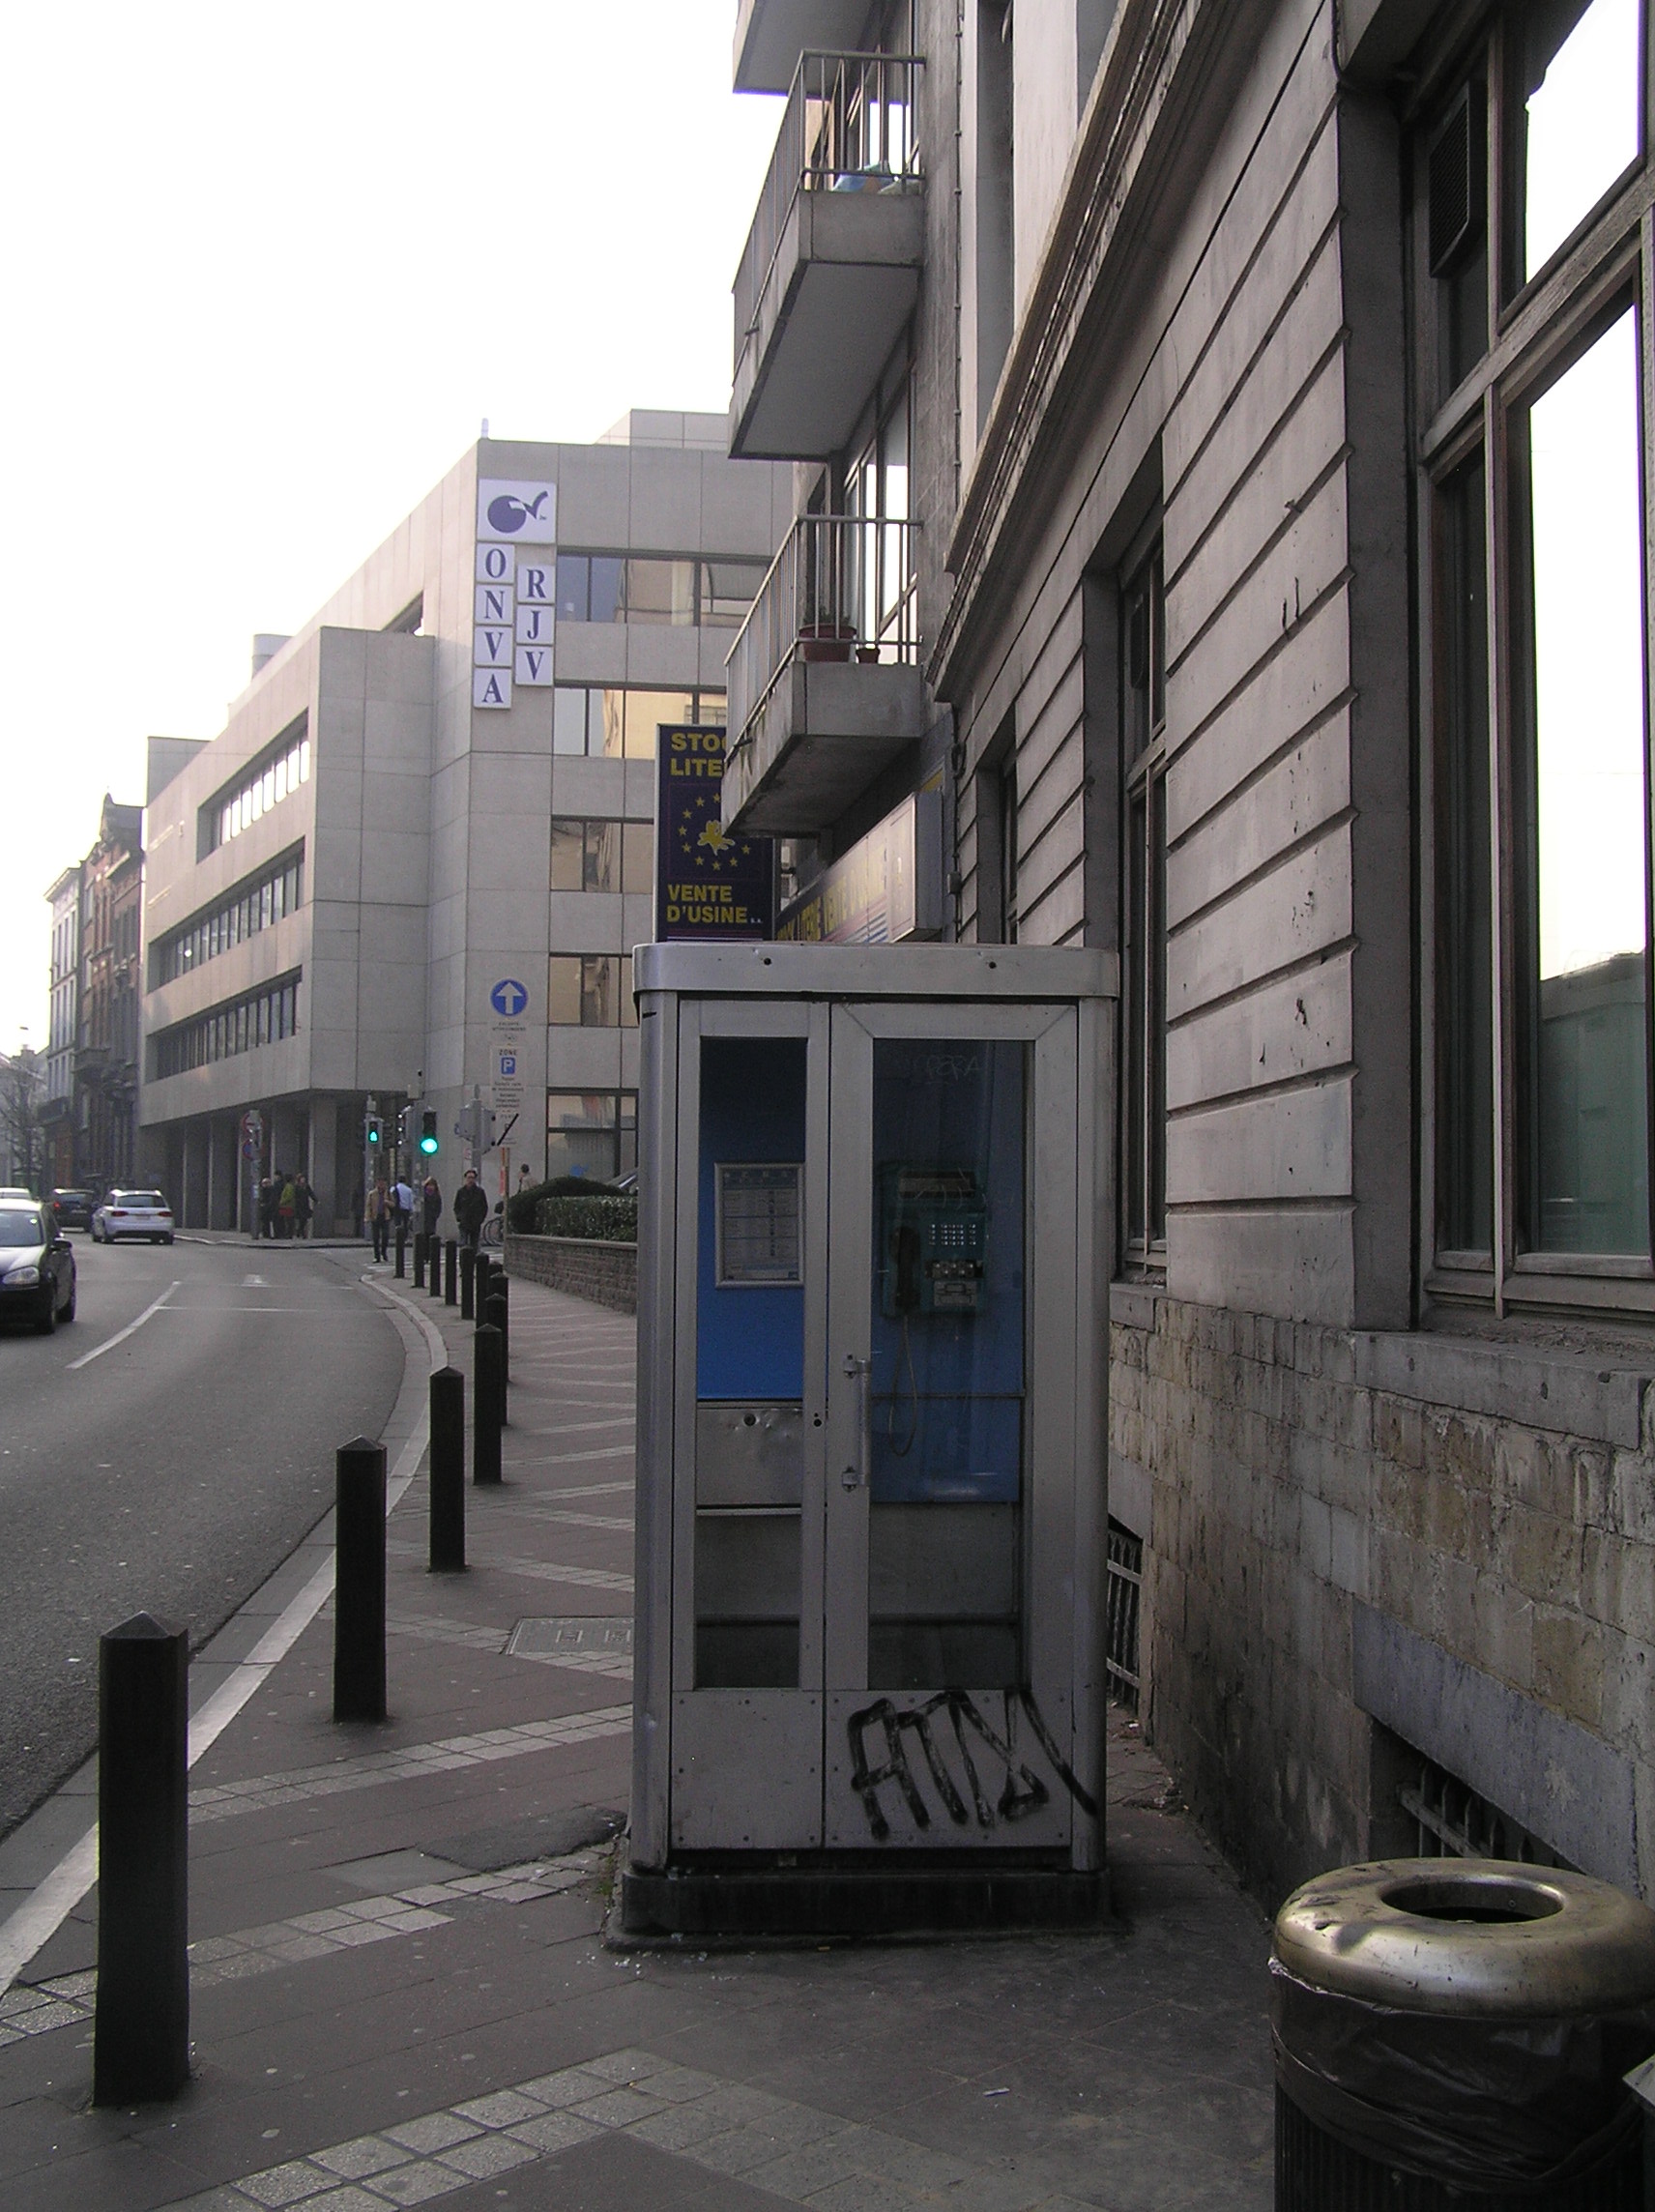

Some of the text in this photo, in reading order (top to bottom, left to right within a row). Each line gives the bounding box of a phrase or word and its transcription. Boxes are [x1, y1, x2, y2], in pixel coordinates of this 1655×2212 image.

[481, 548, 507, 704] ONVA
[525, 568, 546, 681] RJV
[671, 733, 726, 751] STO
[670, 759, 725, 777] LITE
[667, 885, 732, 902] VENTE
[667, 907, 747, 923] D'USINE
[503, 1059, 513, 1073] P
